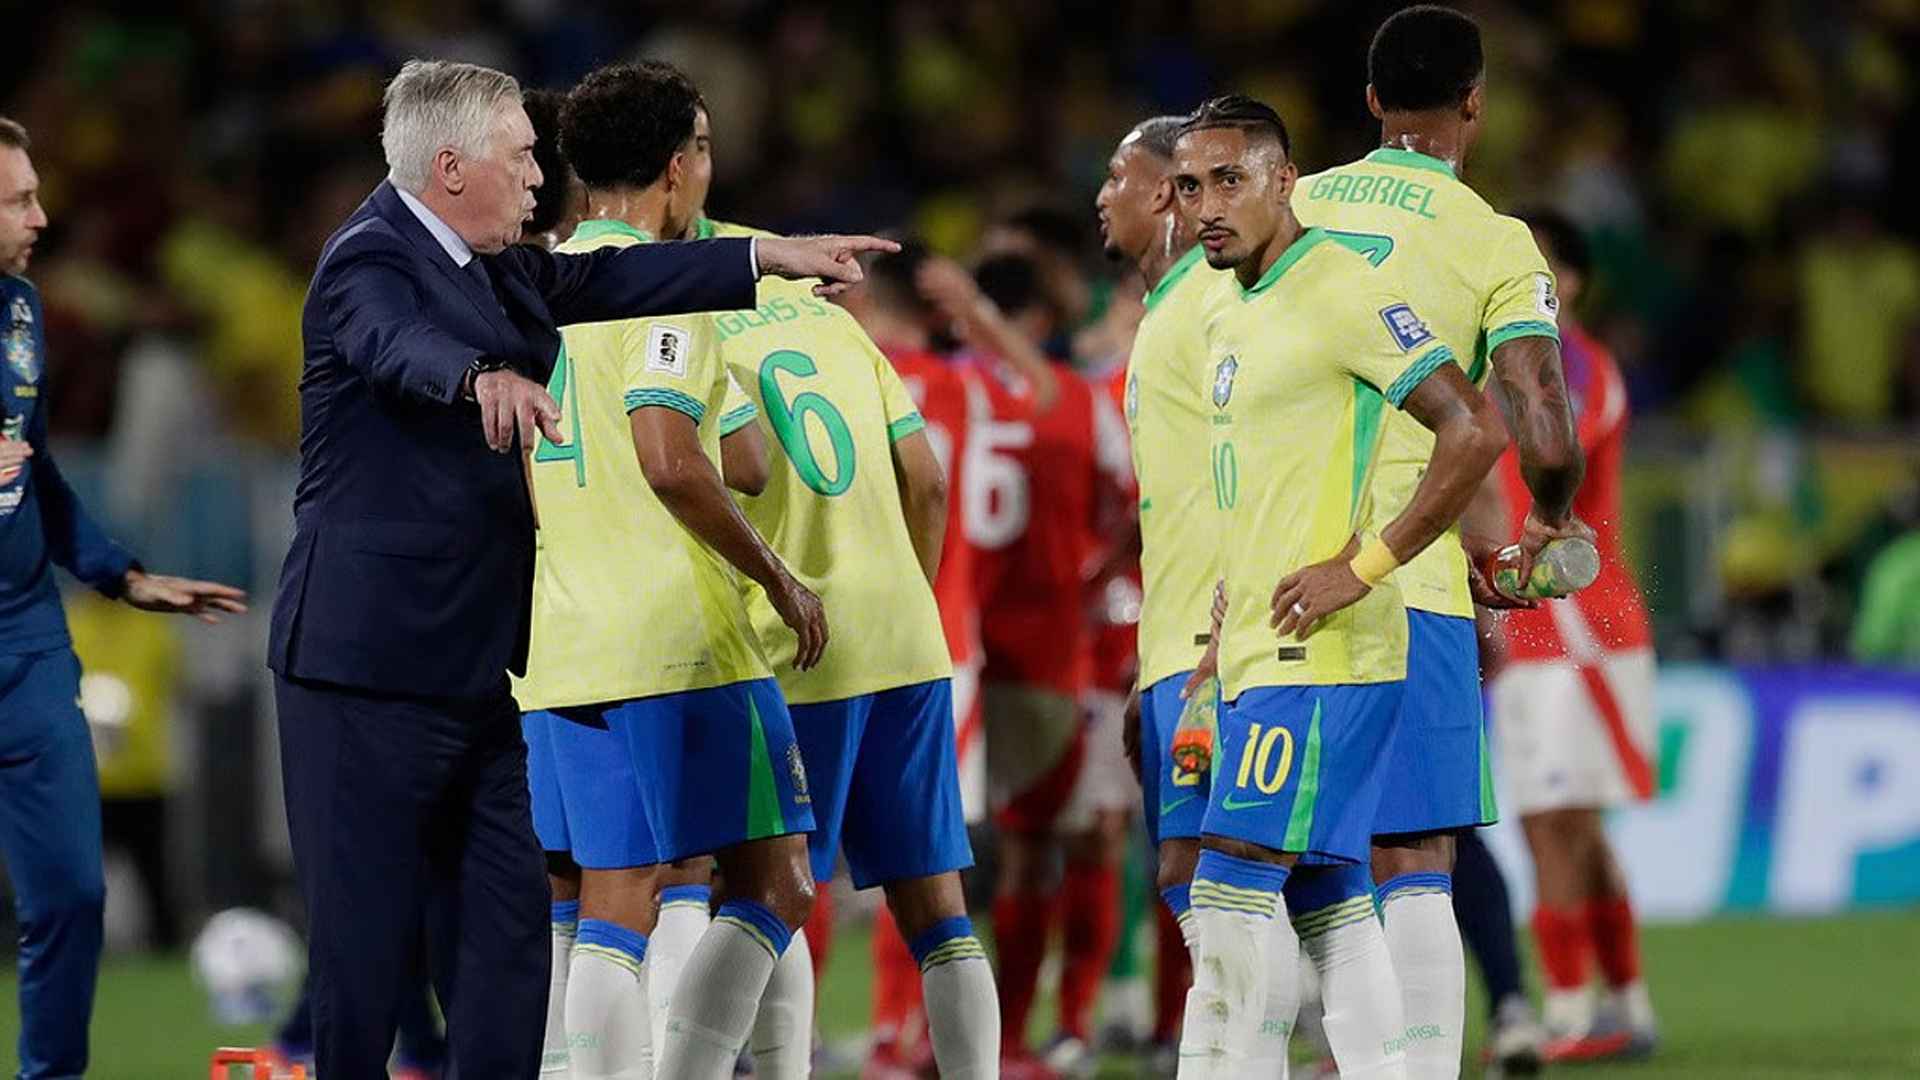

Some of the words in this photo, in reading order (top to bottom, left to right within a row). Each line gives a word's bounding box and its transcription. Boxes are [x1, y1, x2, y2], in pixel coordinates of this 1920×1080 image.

[1309, 174, 1437, 219] GABRIEL
[758, 350, 857, 497] 6
[960, 419, 1035, 550] 6
[1212, 441, 1237, 511] 10
[1236, 723, 1294, 795] 10
